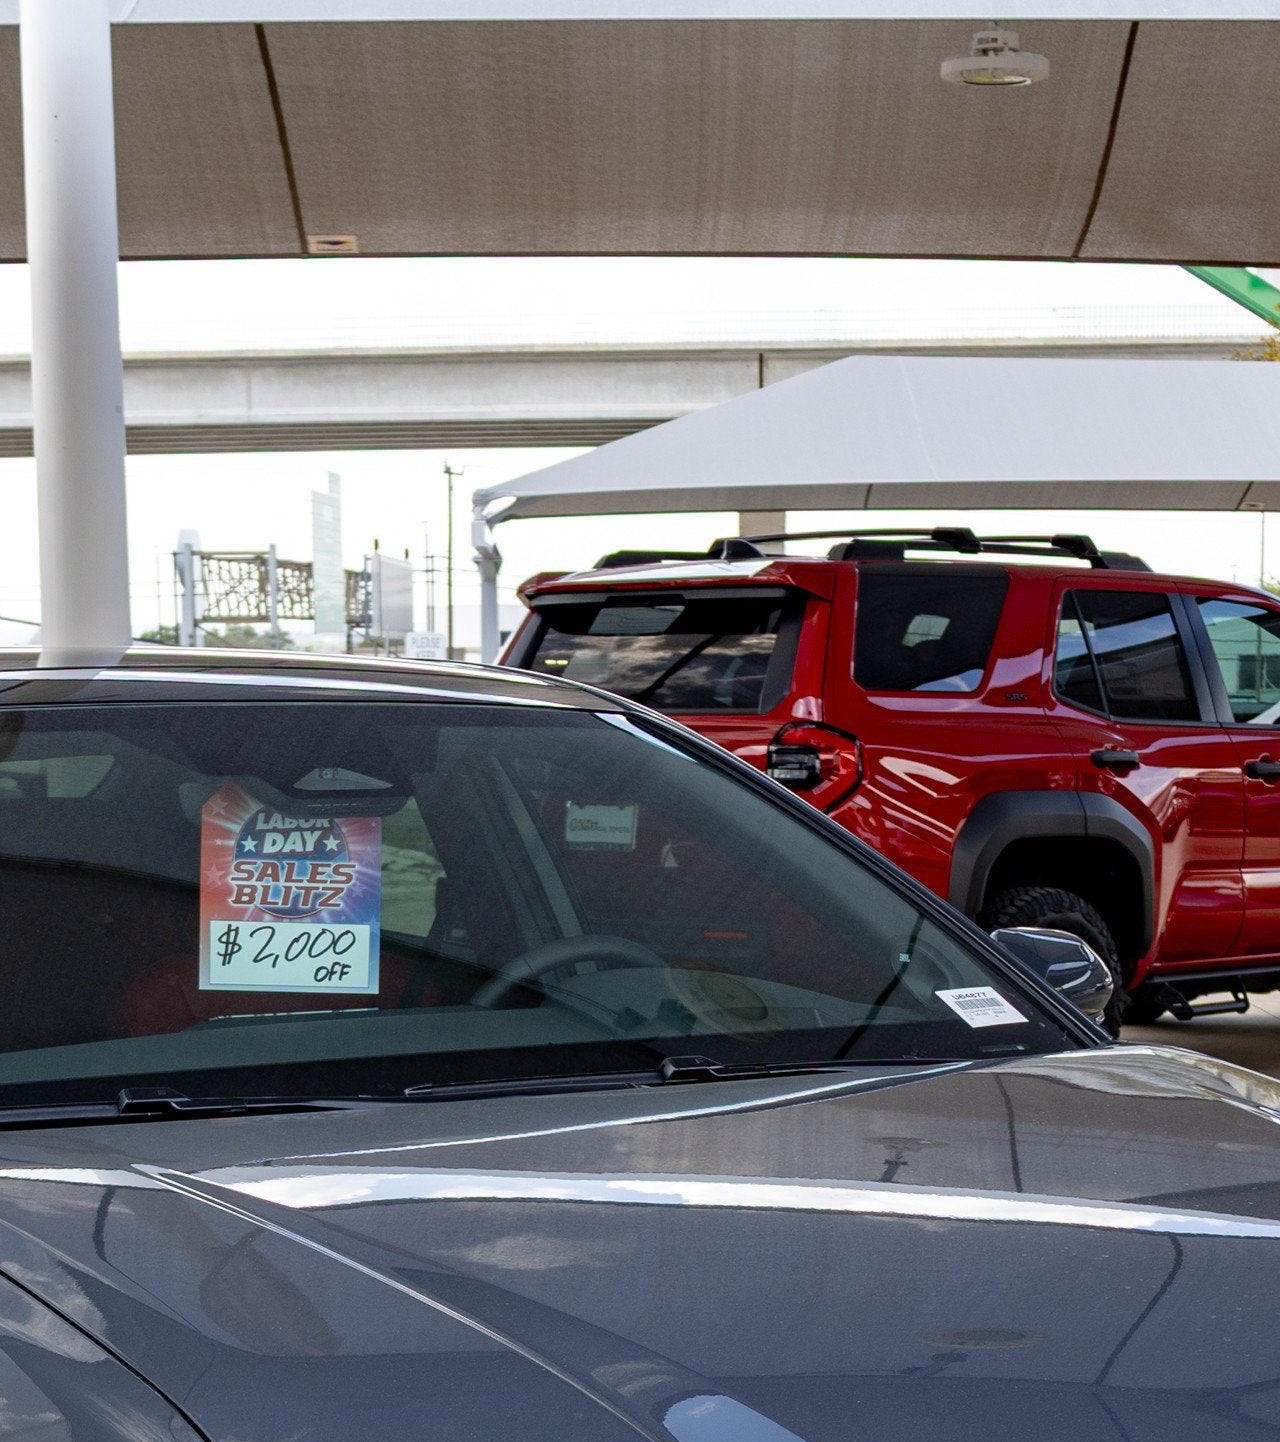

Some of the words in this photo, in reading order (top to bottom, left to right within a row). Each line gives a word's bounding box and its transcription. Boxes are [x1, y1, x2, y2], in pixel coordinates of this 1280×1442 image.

[262, 830, 323, 854] DAY
[230, 860, 357, 885] SALES
[230, 884, 346, 908] BLITZ
